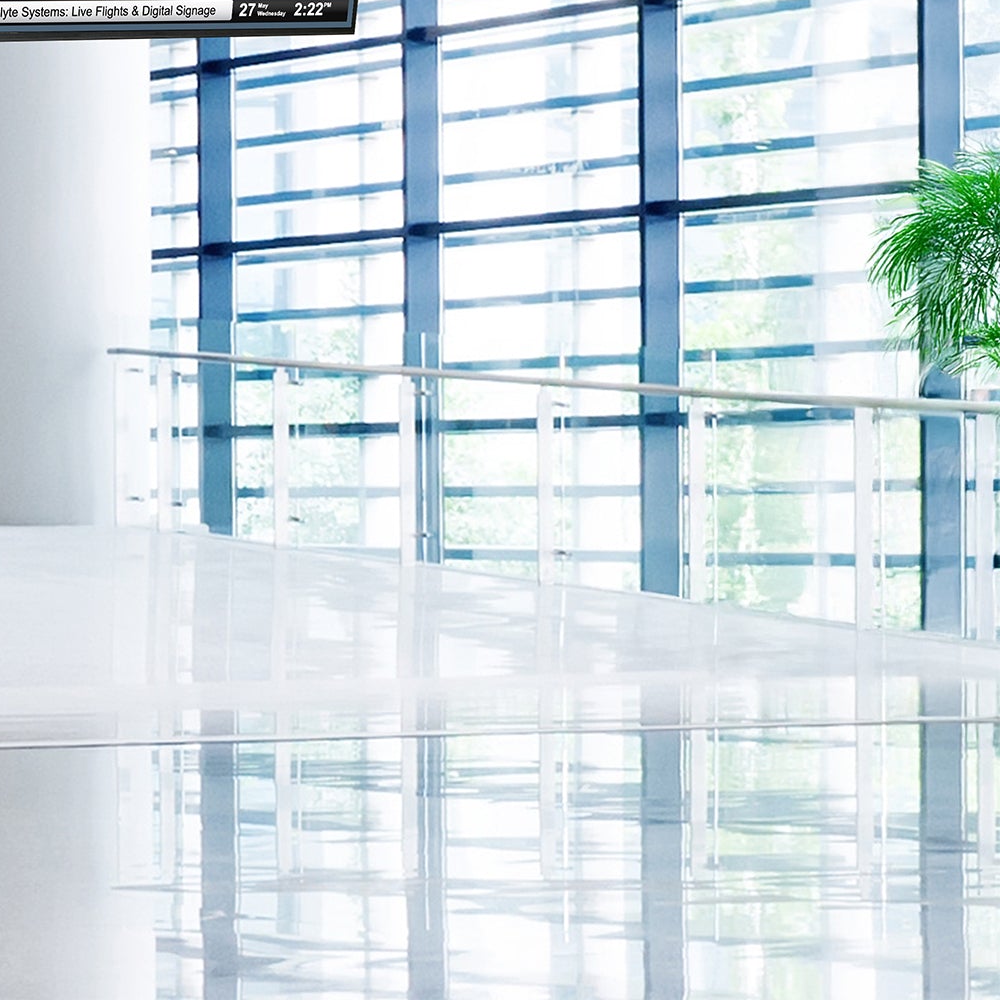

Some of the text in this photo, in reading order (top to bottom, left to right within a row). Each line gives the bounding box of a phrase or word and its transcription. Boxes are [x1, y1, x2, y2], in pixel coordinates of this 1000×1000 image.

[21, 5, 69, 20] Systems:
[71, 6, 93, 17] Live
[95, 5, 129, 19] Flights
[131, 5, 139, 16] &
[142, 5, 173, 19] Digital
[175, 4, 217, 19] Signage
[239, 2, 257, 17] 27
[256, 10, 287, 18] Wednesday
[293, 2, 324, 16] 2:22
